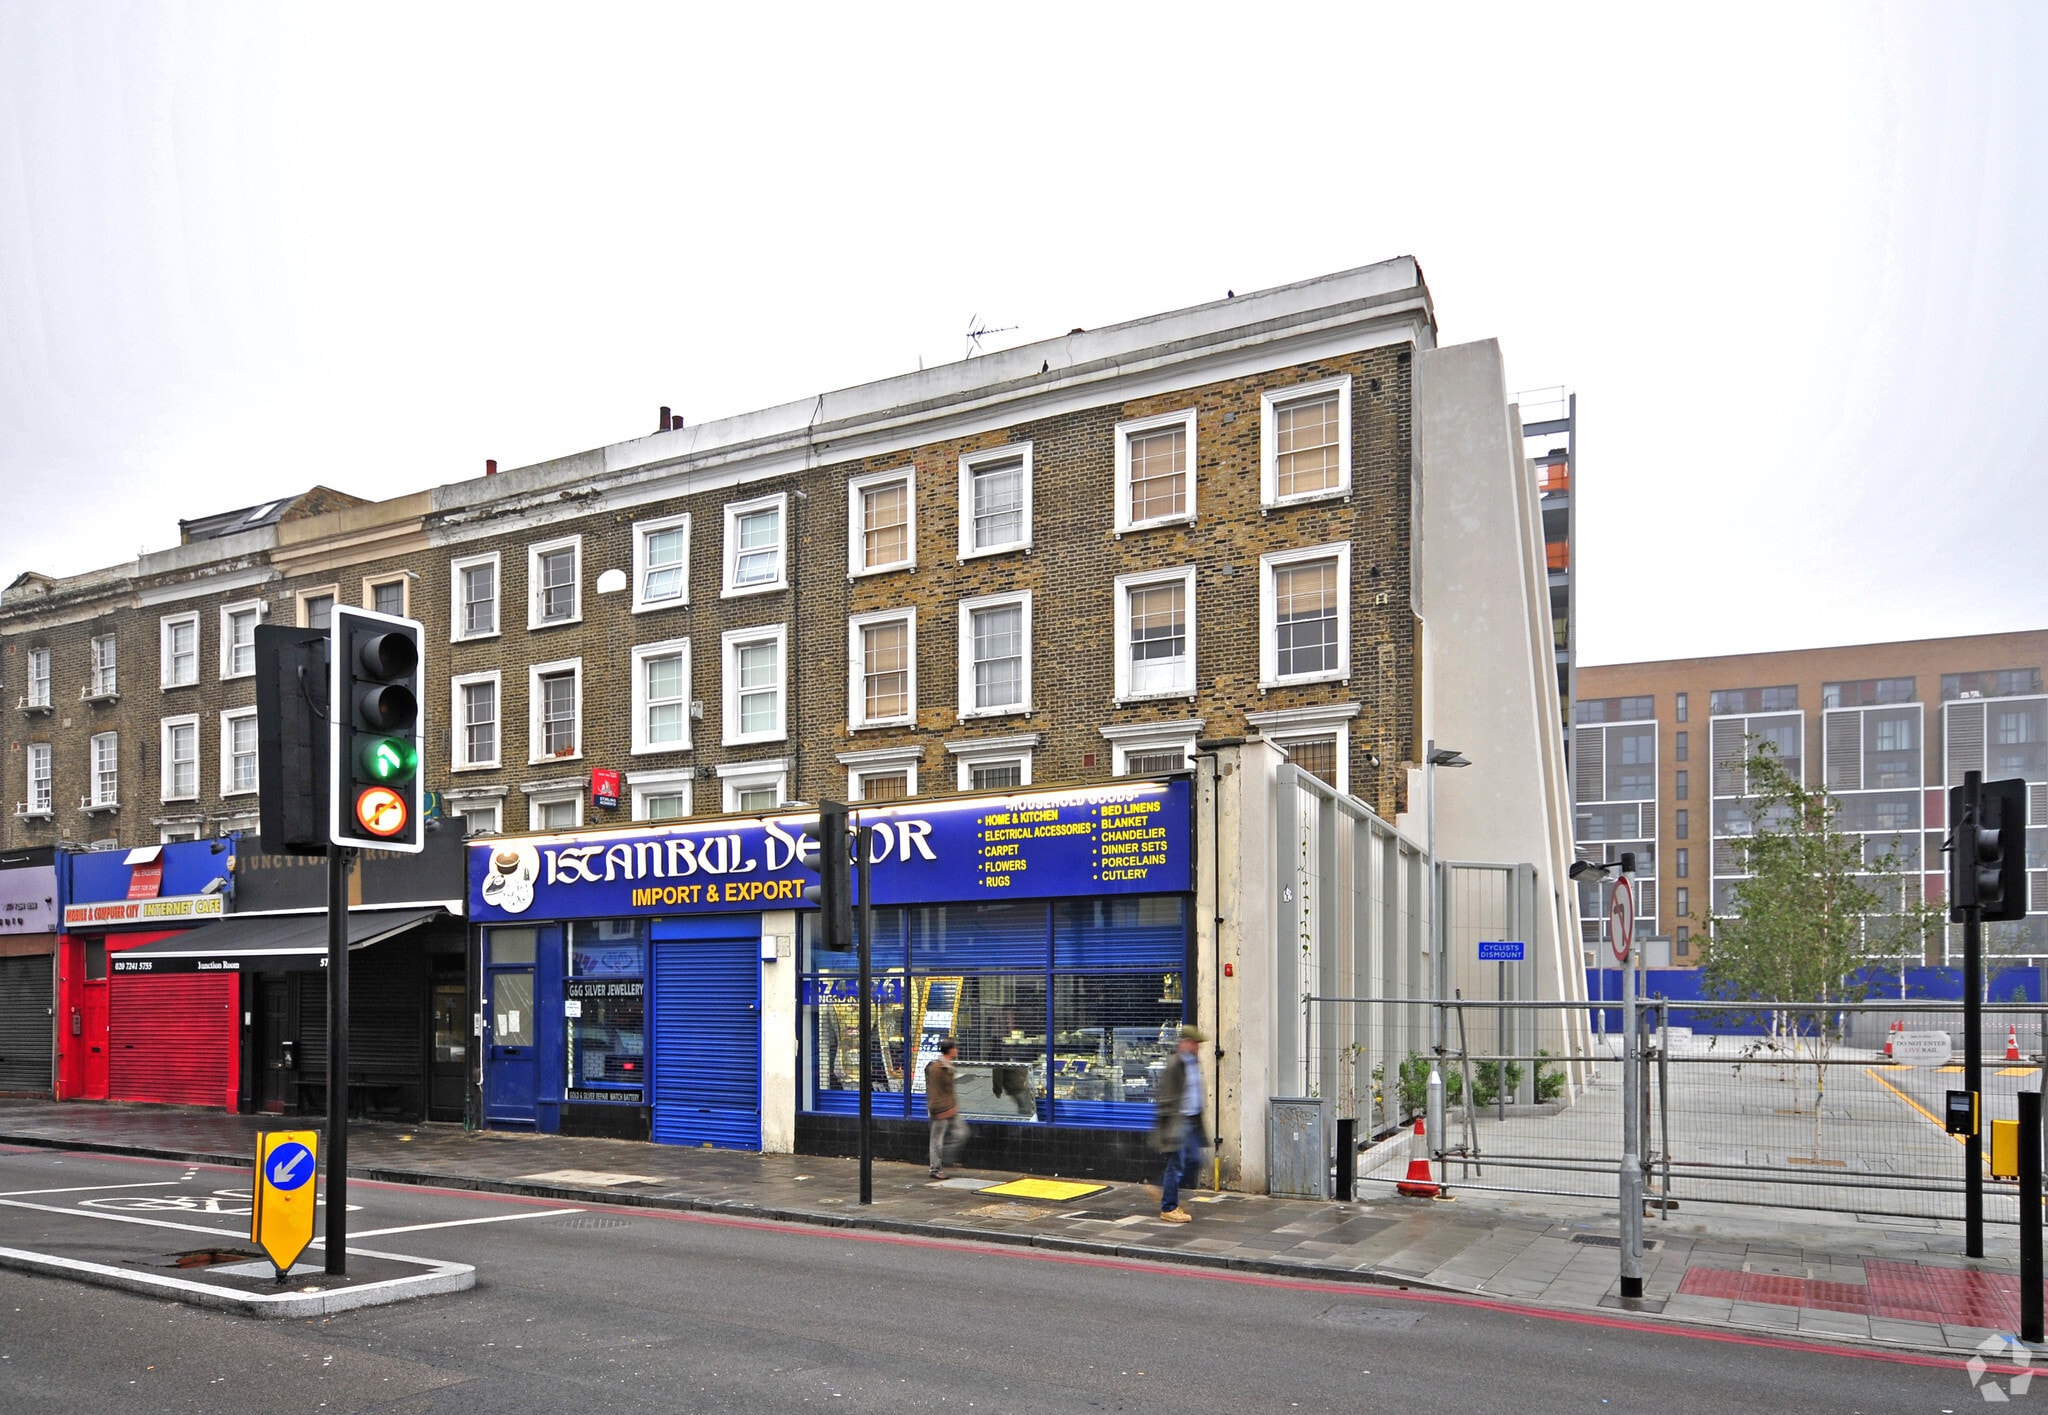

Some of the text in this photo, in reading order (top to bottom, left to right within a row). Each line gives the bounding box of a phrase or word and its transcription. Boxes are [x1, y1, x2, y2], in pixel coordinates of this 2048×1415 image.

[1101, 801, 1160, 816] BED LINENS
[984, 809, 1058, 826] HOME & KITCHEN
[1101, 816, 1148, 829] BLANKET
[984, 822, 1092, 841] ELECTRICAL ACCESSORIES
[1101, 828, 1166, 842] CHANDELIER
[544, 820, 937, 886] ISTANBUL DEOR
[984, 844, 1019, 857] CARPET
[1101, 840, 1167, 855] DINNER SETS
[985, 860, 1027, 872] FLOWERS
[1102, 854, 1166, 868] PORCELAINS
[1102, 868, 1148, 880] CUTLERY
[986, 876, 1010, 887] RUGS
[632, 879, 805, 906] IMPORT & EXPORT
[66, 898, 220, 923] MOBILE & COMPUTER CITY INTERNET CAFE
[114, 962, 125, 970] 020
[198, 961, 240, 969] Junction Room
[569, 984, 583, 996] G&G
[607, 984, 644, 996] JEWELLERY
